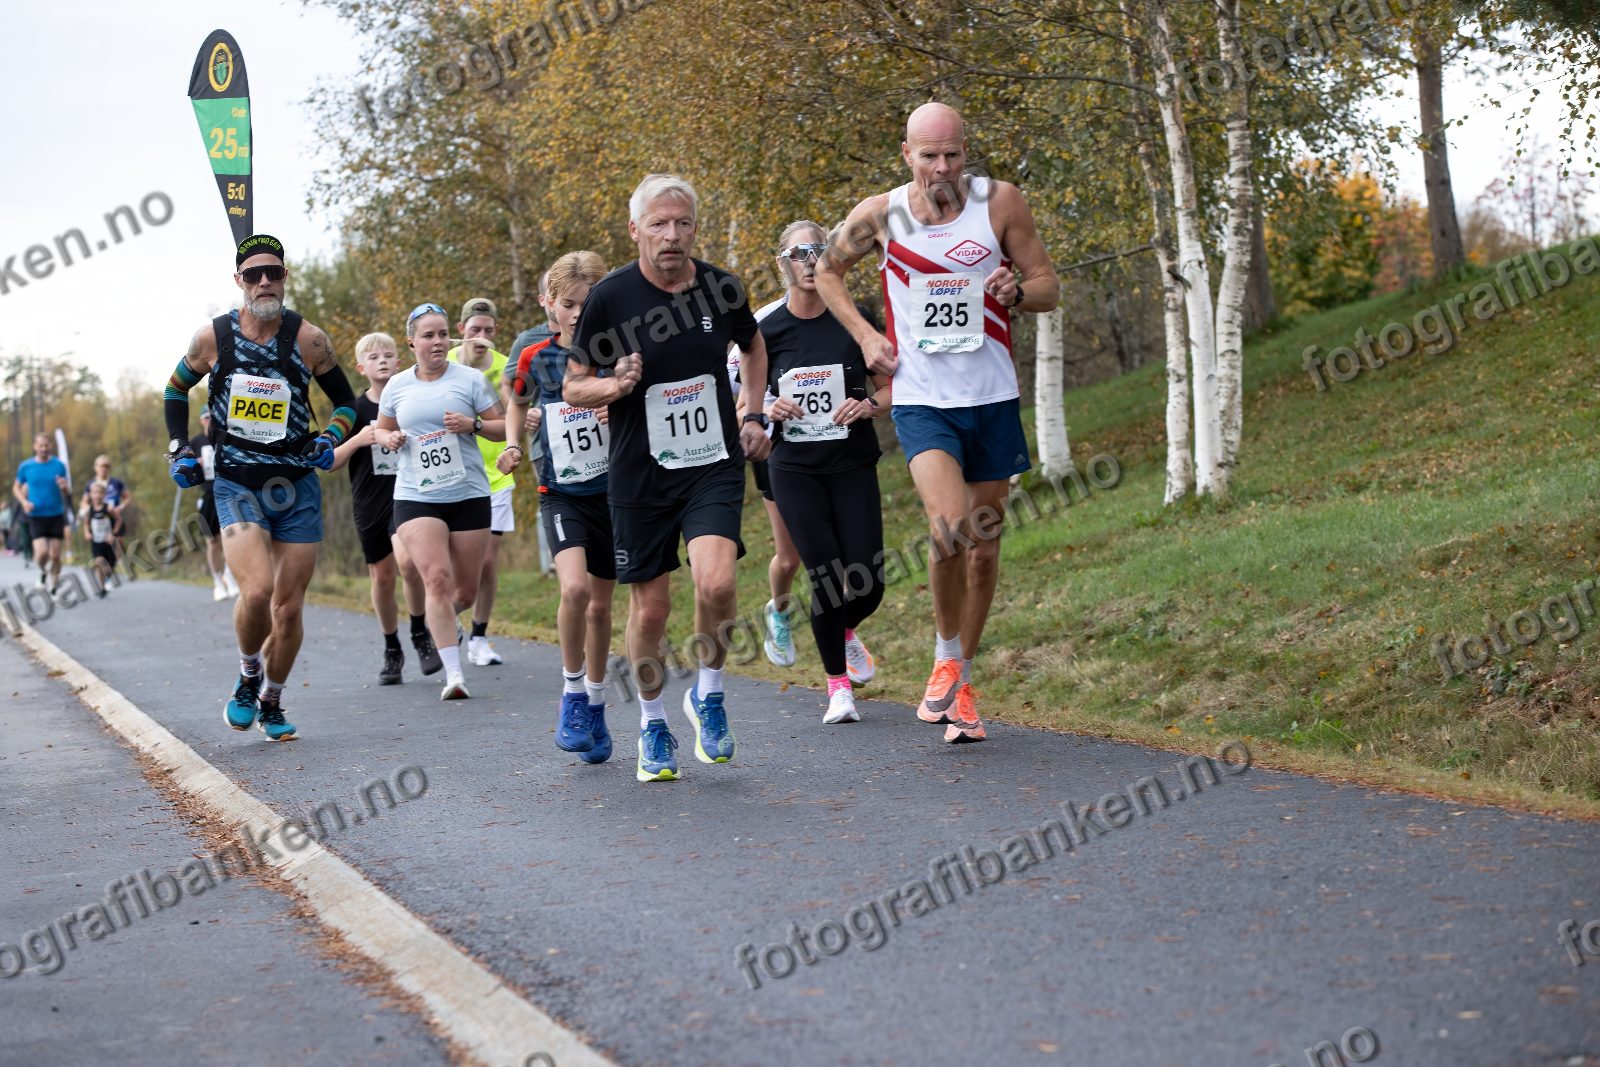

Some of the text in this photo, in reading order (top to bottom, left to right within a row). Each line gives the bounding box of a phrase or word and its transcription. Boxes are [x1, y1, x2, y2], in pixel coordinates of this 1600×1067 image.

[209, 127, 238, 160] 25
[955, 249, 984, 257] VIDAR
[926, 279, 970, 288] NORGES
[929, 287, 964, 296] LØPET
[924, 302, 969, 328] 235
[792, 371, 832, 380] NORGES
[244, 380, 282, 391] NORGES
[247, 386, 275, 396] LØPET
[662, 382, 705, 398] NORGES
[667, 392, 701, 406] LØPET
[792, 391, 833, 415] 763
[234, 399, 284, 420] PACE
[563, 410, 594, 424] LØPET
[664, 406, 708, 438] 110
[418, 430, 447, 442] NORGES
[562, 423, 604, 454] 151
[683, 442, 723, 457] Aurskog
[420, 446, 452, 469] 963
